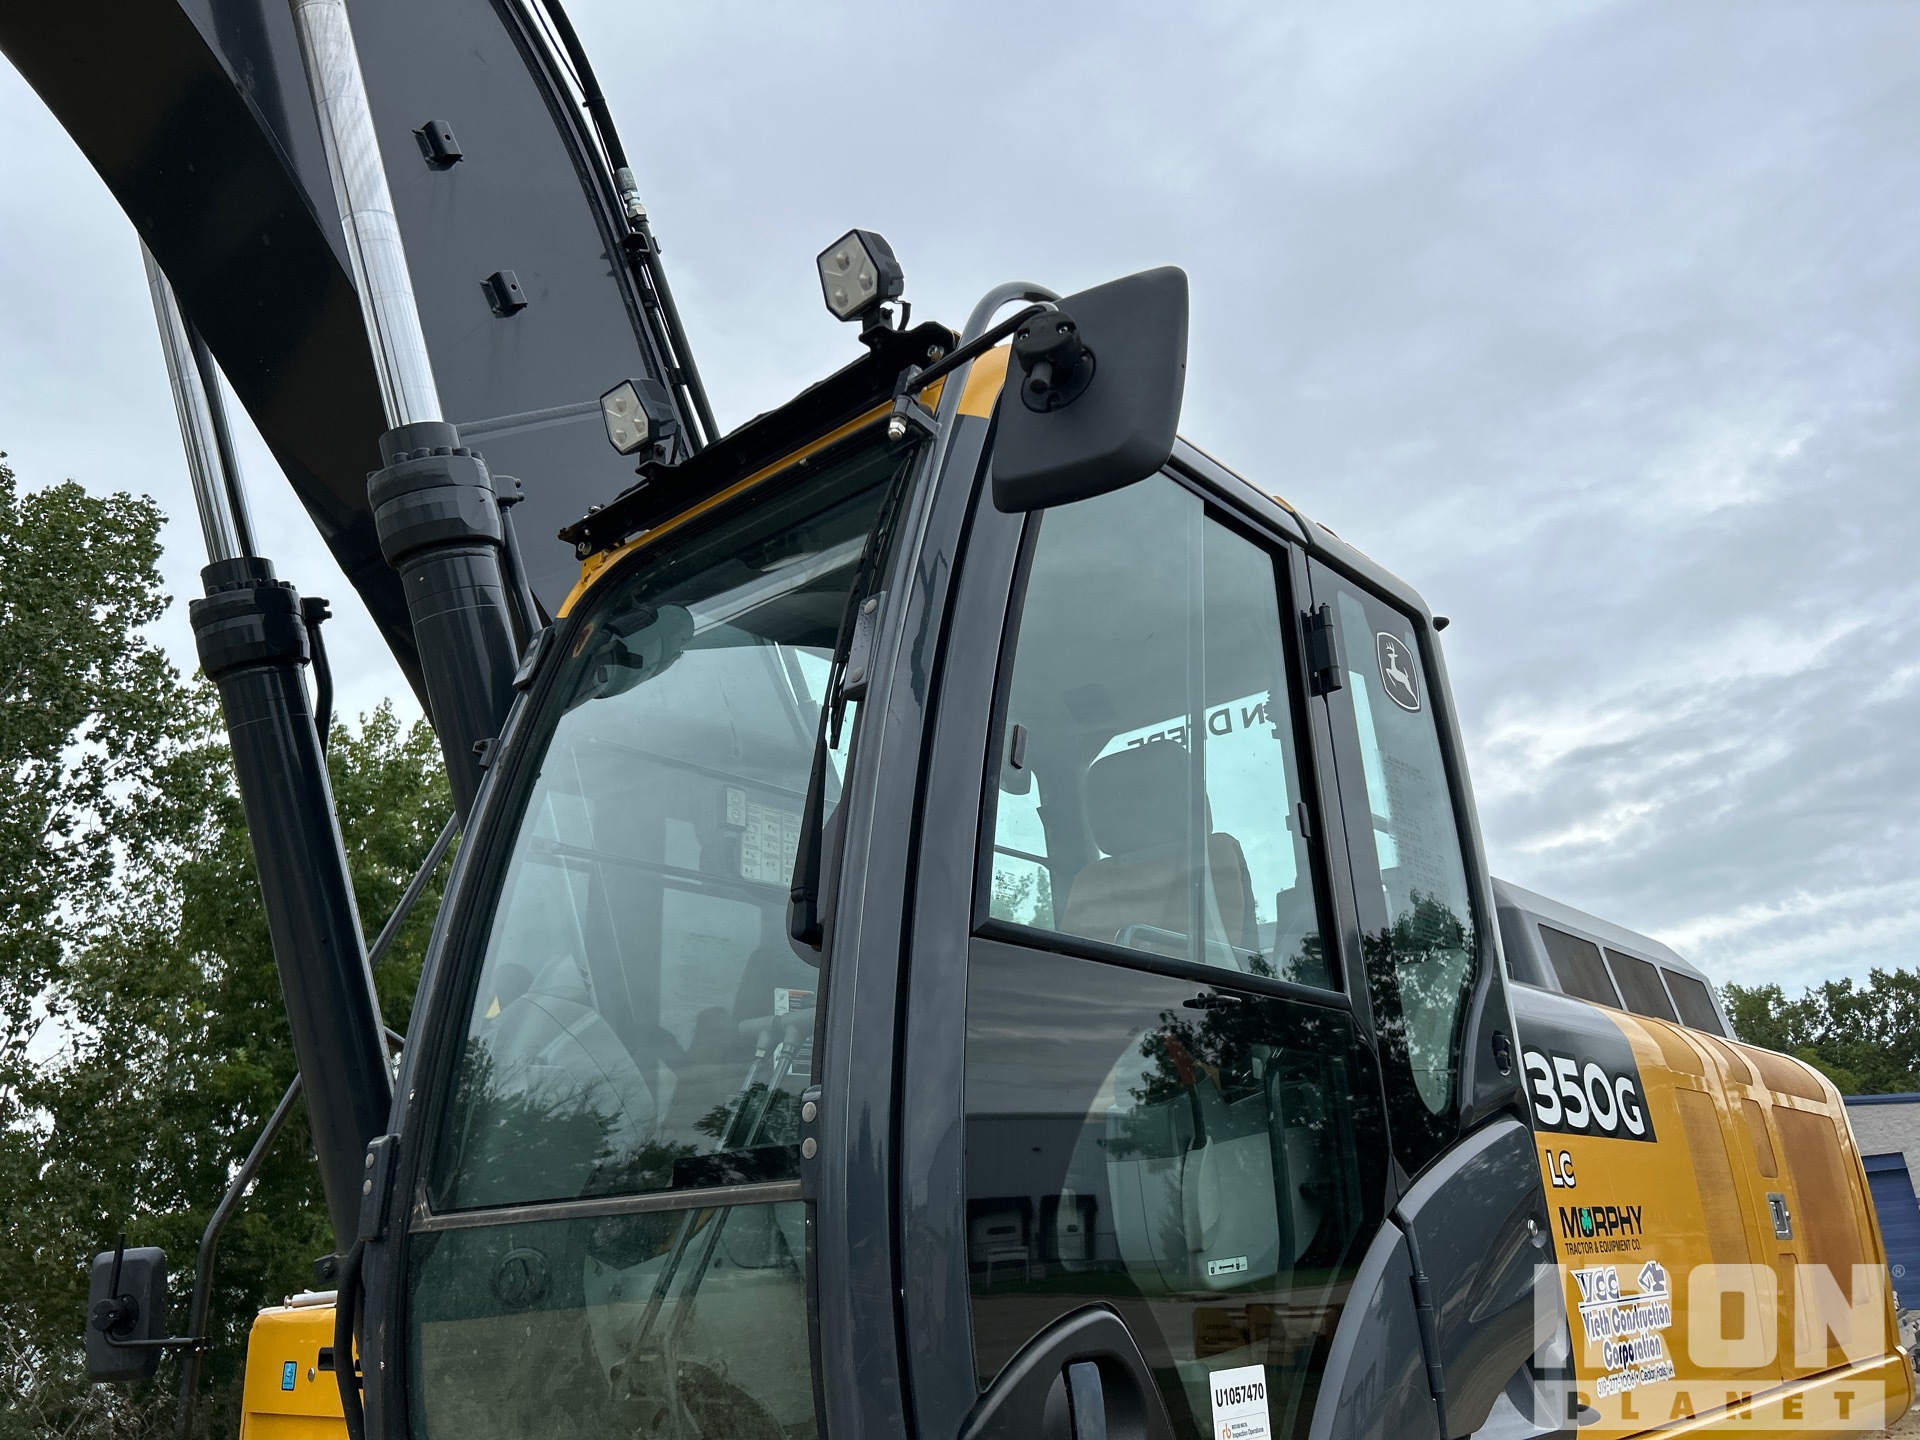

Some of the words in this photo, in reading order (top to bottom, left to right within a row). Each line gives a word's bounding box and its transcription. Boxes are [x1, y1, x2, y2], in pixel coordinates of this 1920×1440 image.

[1523, 1051, 1646, 1136] 350G
[1546, 1150, 1576, 1188] LC
[1558, 1205, 1643, 1239] MURPHY
[1565, 1241, 1594, 1256] TRACTOR
[1594, 1241, 1600, 1253] &
[1600, 1239, 1631, 1253] EQUIPMENT
[1583, 1309, 1612, 1339] Vieth
[1611, 1302, 1670, 1333] Construction
[1604, 1334, 1661, 1369] Corporation
[1215, 1382, 1264, 1407] U1057470
